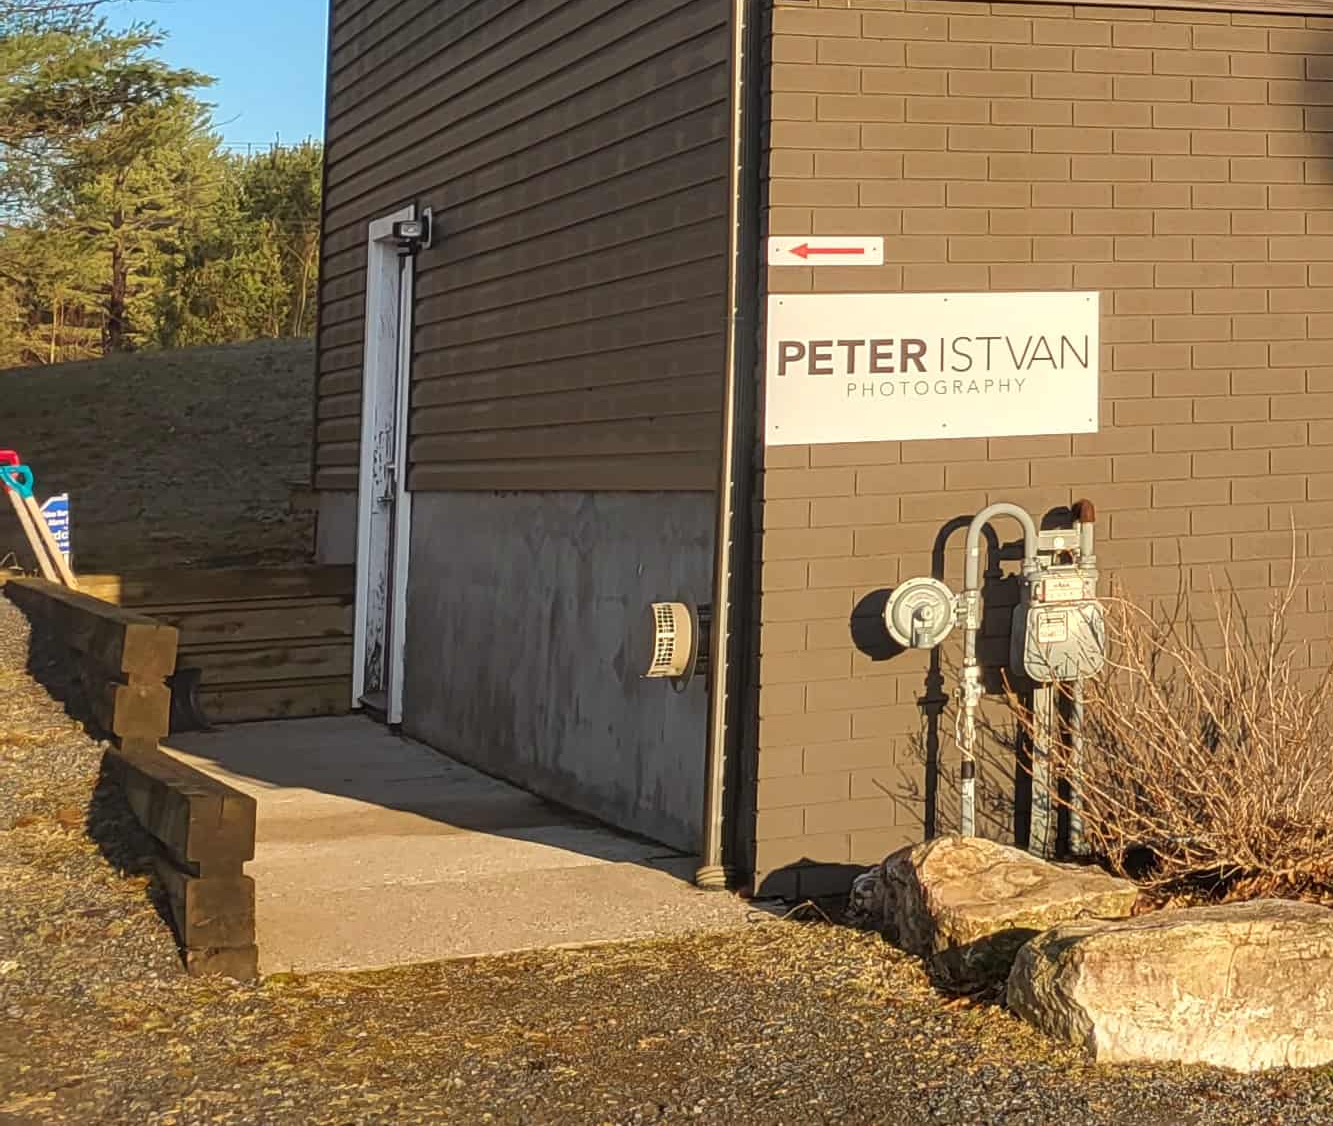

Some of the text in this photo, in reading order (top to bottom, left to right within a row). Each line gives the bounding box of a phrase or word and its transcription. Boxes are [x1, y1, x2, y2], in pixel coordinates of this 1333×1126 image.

[777, 334, 1089, 376] PETER ISTVAN
[847, 377, 1026, 397] PHOTOGRAPHY
